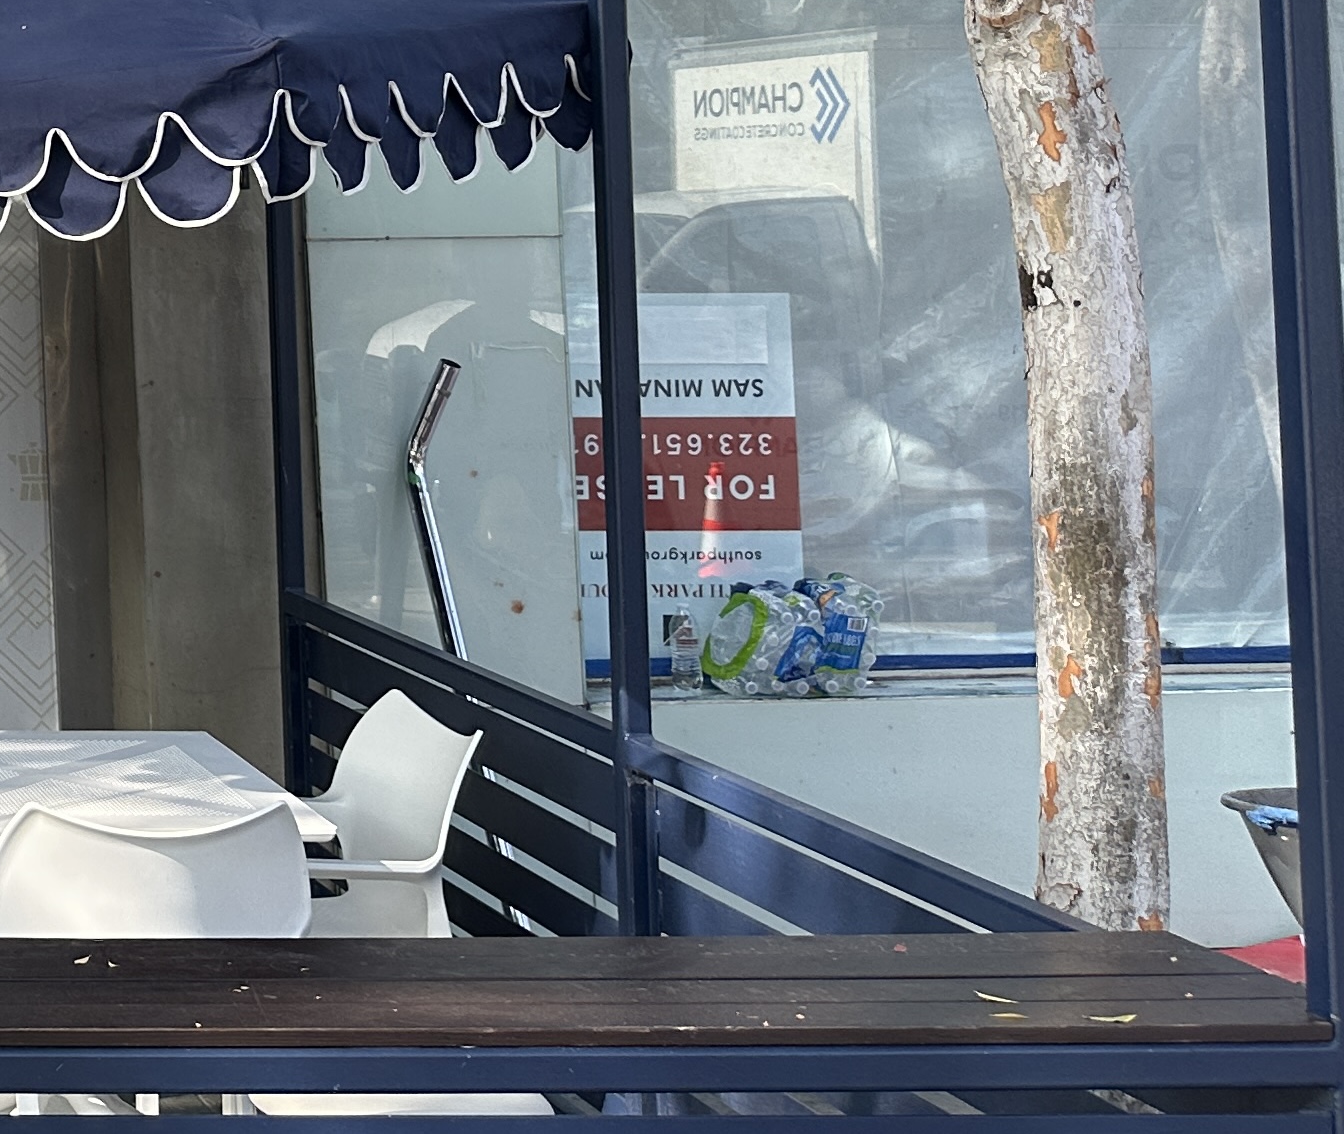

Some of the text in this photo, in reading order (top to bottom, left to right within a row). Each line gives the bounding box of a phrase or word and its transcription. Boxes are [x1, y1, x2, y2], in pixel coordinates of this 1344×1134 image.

[576, 378, 764, 398] SAM MINAN
[574, 433, 772, 456] 323.651.9
[574, 474, 775, 500] FOR LESE
[651, 584, 703, 598] PARK
